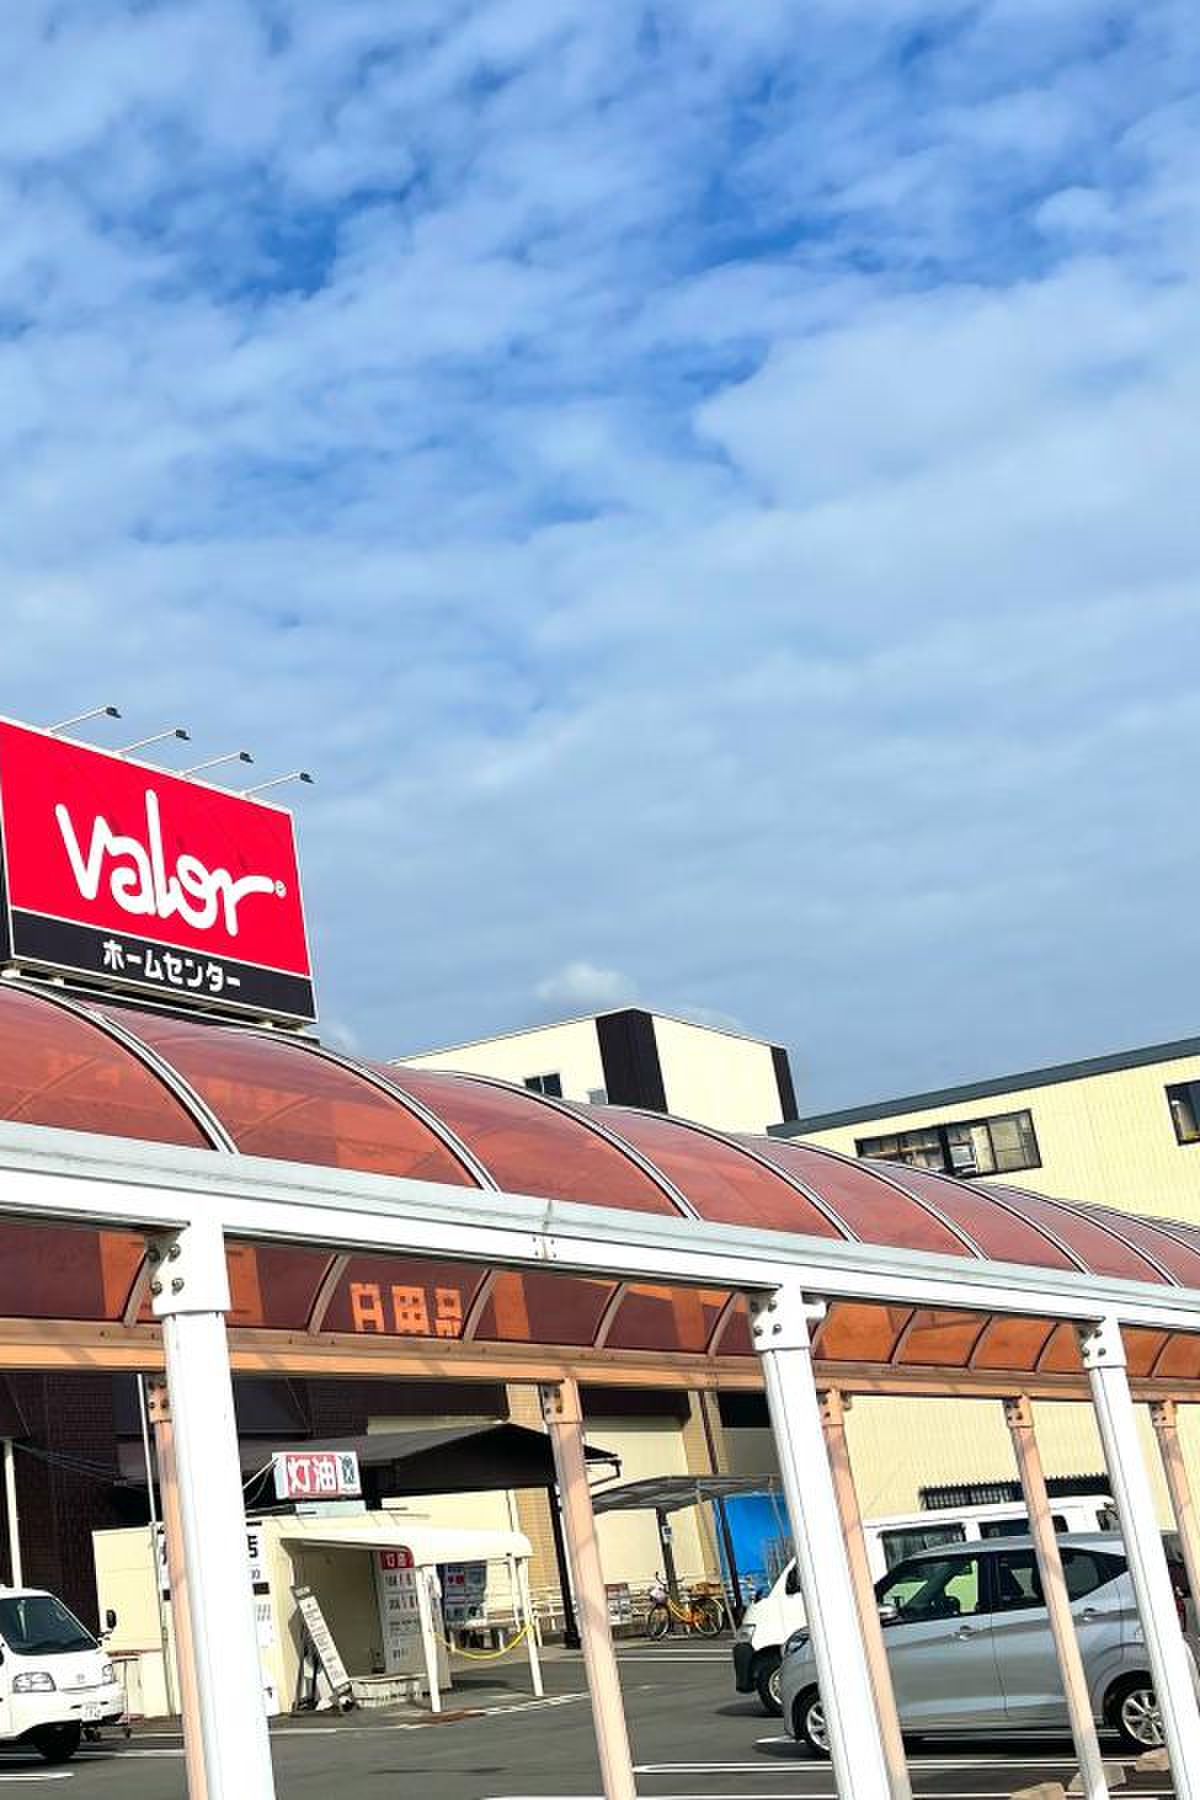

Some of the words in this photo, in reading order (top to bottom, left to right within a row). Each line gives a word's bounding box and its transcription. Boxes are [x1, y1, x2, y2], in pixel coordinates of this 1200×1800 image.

[103, 939, 241, 992] ホームセンター
[288, 1457, 337, 1493] 灯油
